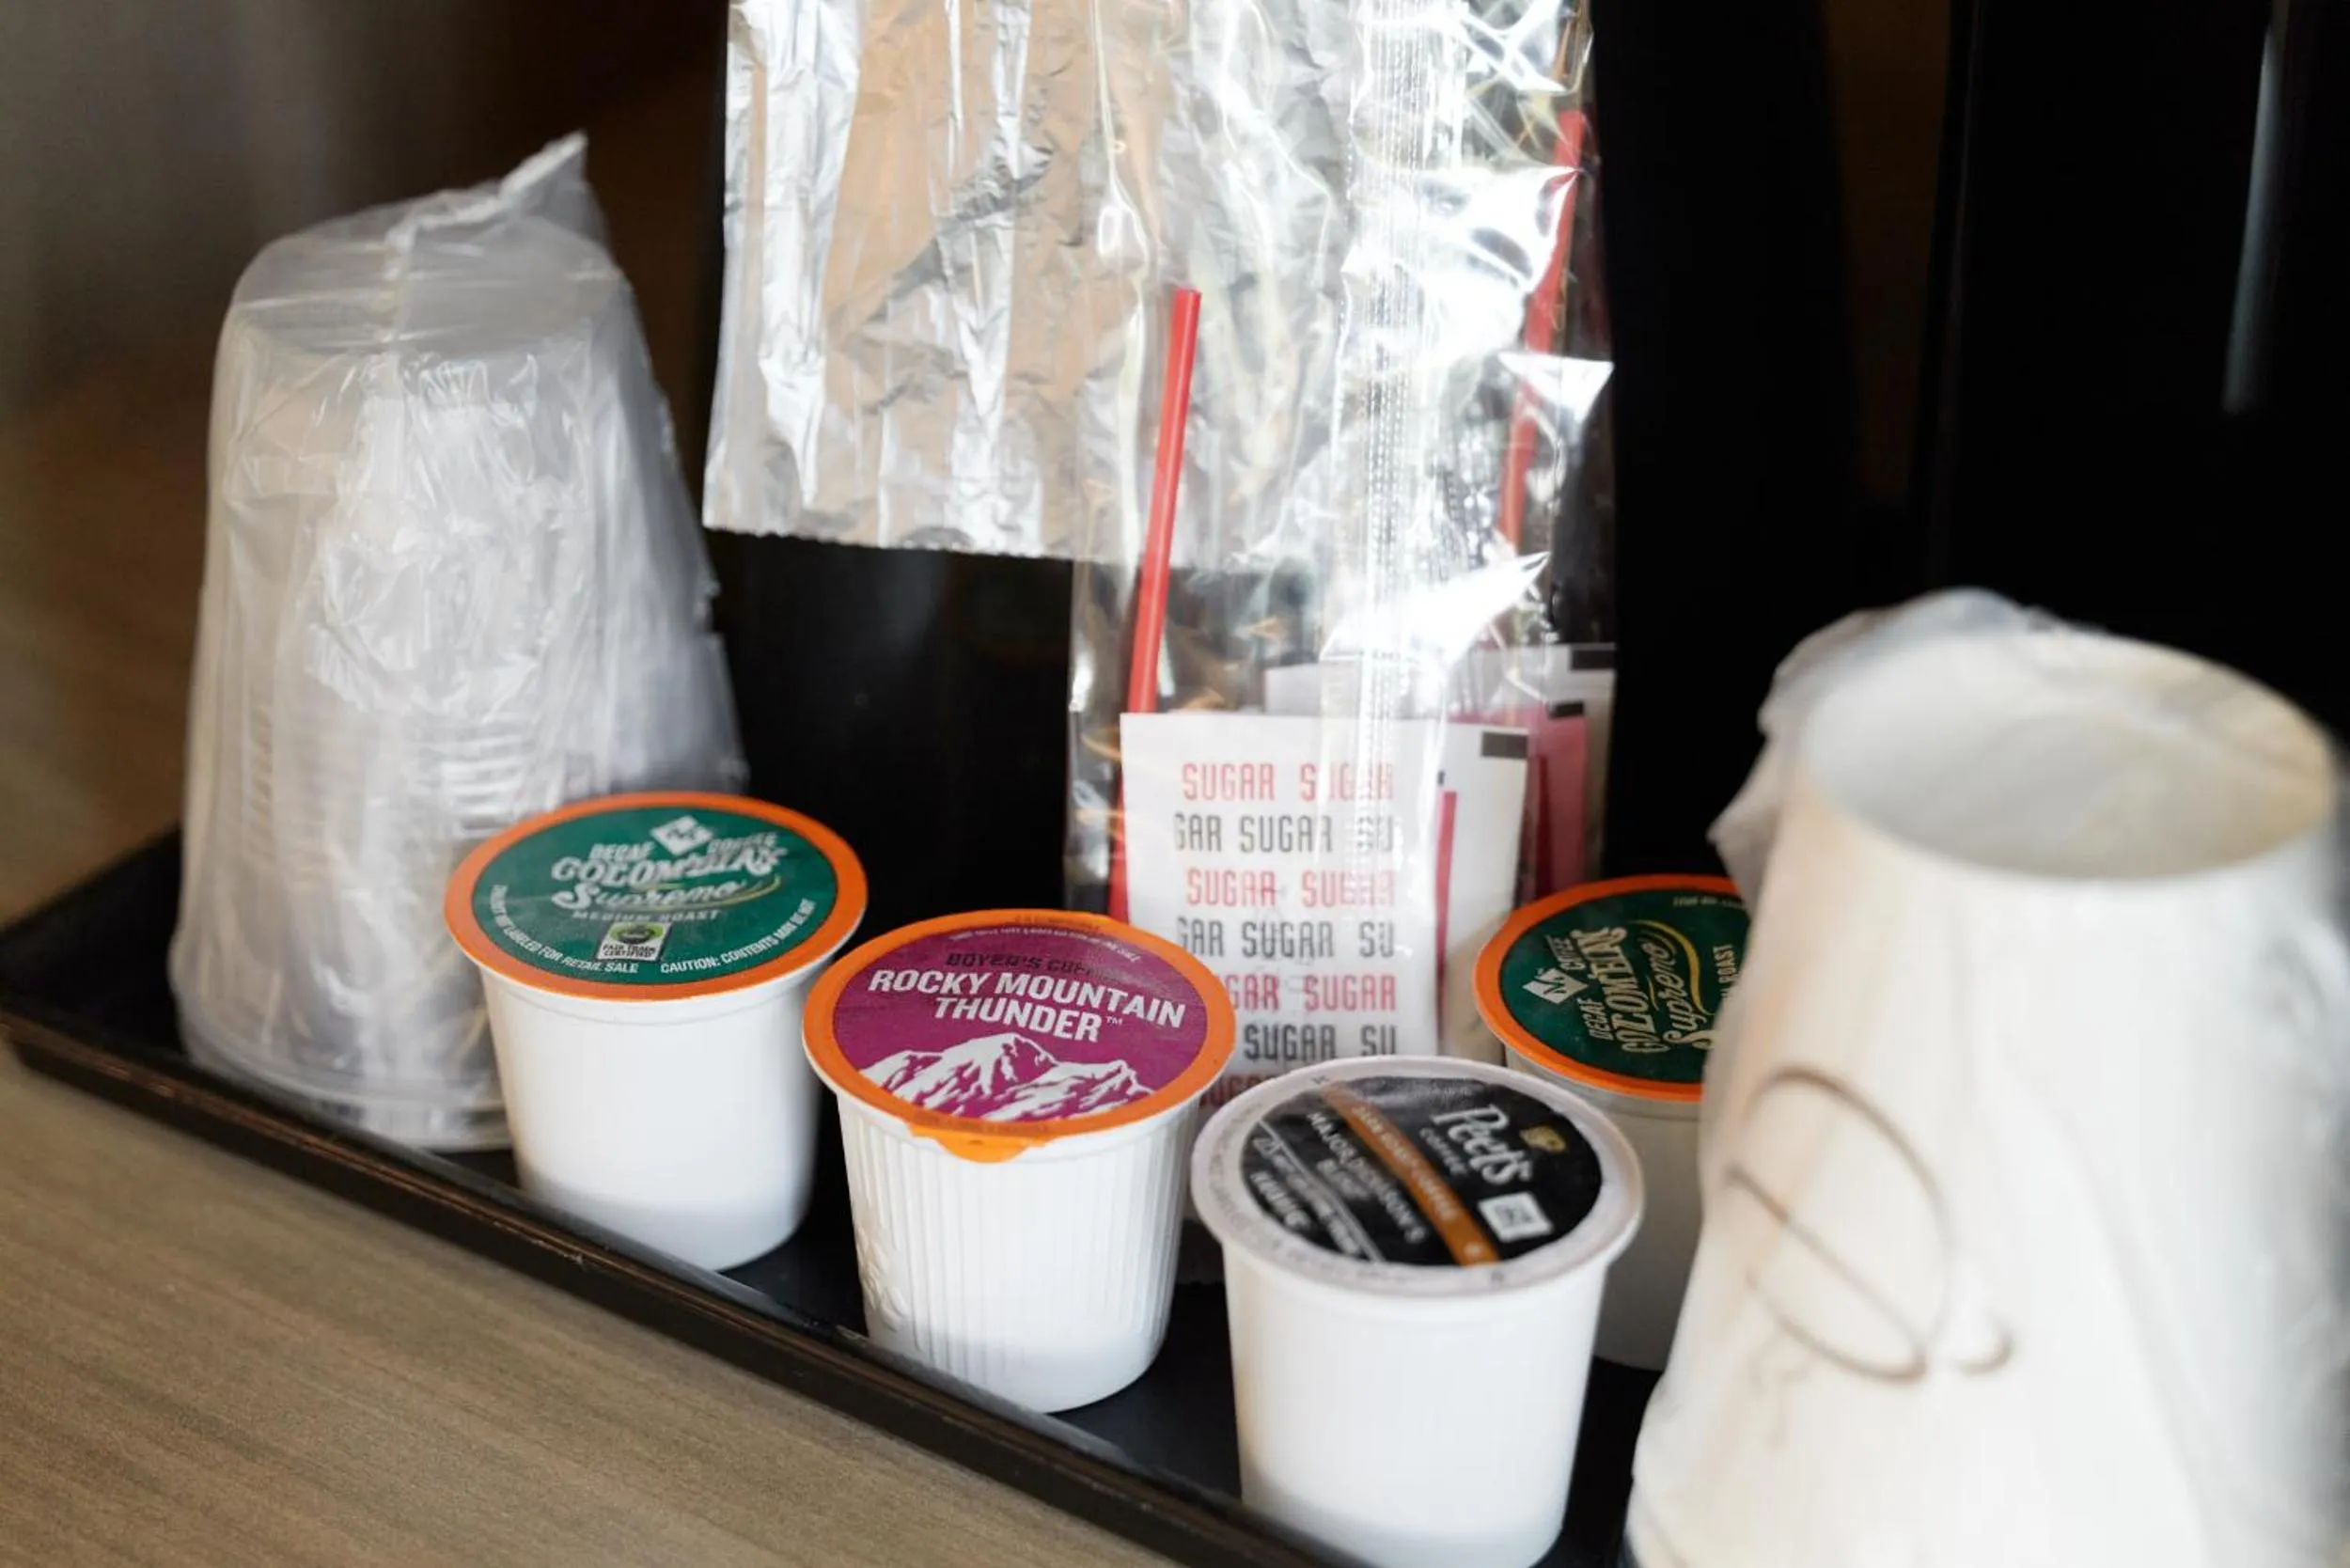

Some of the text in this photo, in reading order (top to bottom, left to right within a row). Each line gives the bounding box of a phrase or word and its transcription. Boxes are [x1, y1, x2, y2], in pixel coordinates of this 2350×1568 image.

[1182, 762, 1276, 801] SUGAR
[1240, 815, 1333, 854] SUGAR
[1186, 869, 1277, 907] SUGAR
[660, 910, 721, 922] ROAST
[661, 955, 721, 974] CAUTION:
[720, 935, 780, 964] CONTENTS
[1242, 921, 1334, 959] SUGAR
[1359, 921, 1395, 958] SU
[603, 962, 639, 974] SALE
[946, 953, 1043, 970] BOYER'S
[868, 969, 1186, 1029] ROCKY MOUNTAIN
[1225, 974, 1396, 1012] GAR SUGAR
[933, 996, 1104, 1043] THUNDER
[1577, 996, 1614, 1041] DECAF
[1244, 1024, 1397, 1062] SUGAR SU
